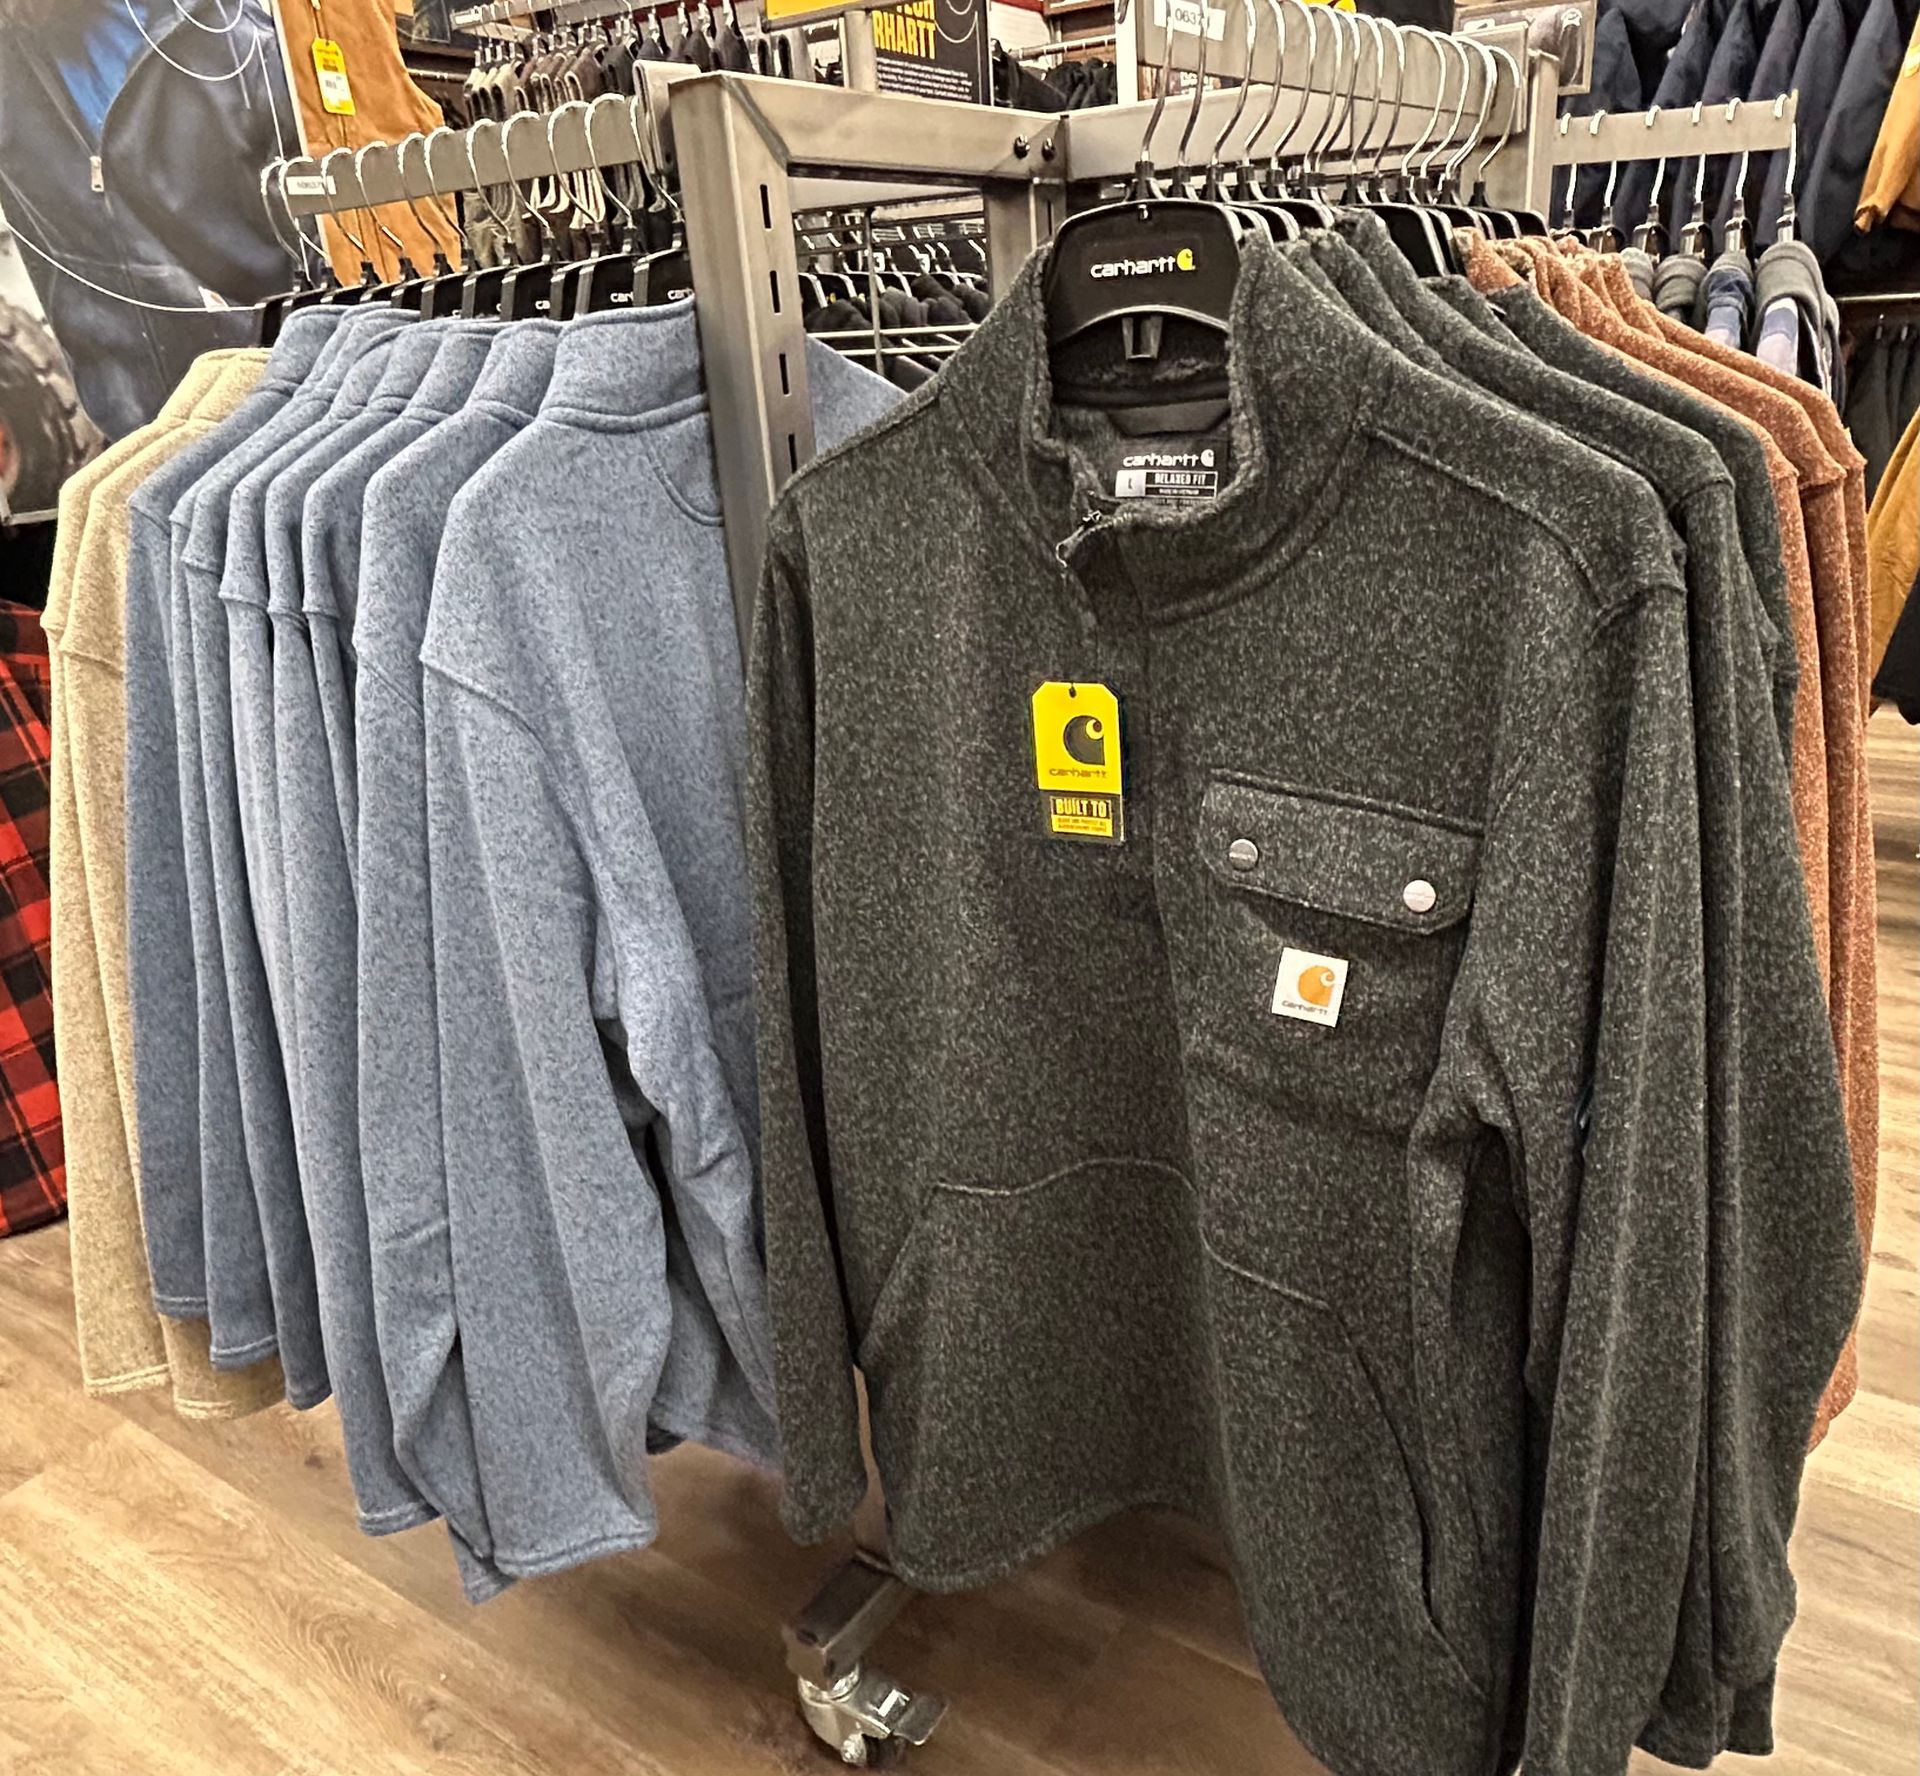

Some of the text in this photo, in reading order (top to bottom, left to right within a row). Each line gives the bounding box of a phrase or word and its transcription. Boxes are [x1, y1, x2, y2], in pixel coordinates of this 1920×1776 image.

[1090, 255, 1175, 278] carhartt
[1123, 452, 1199, 467] carhartt
[1193, 474, 1206, 486] FIT
[1049, 767, 1106, 779] carhartt
[1055, 798, 1107, 818] BUILT TO
[1281, 1000, 1328, 1016] carhartt
